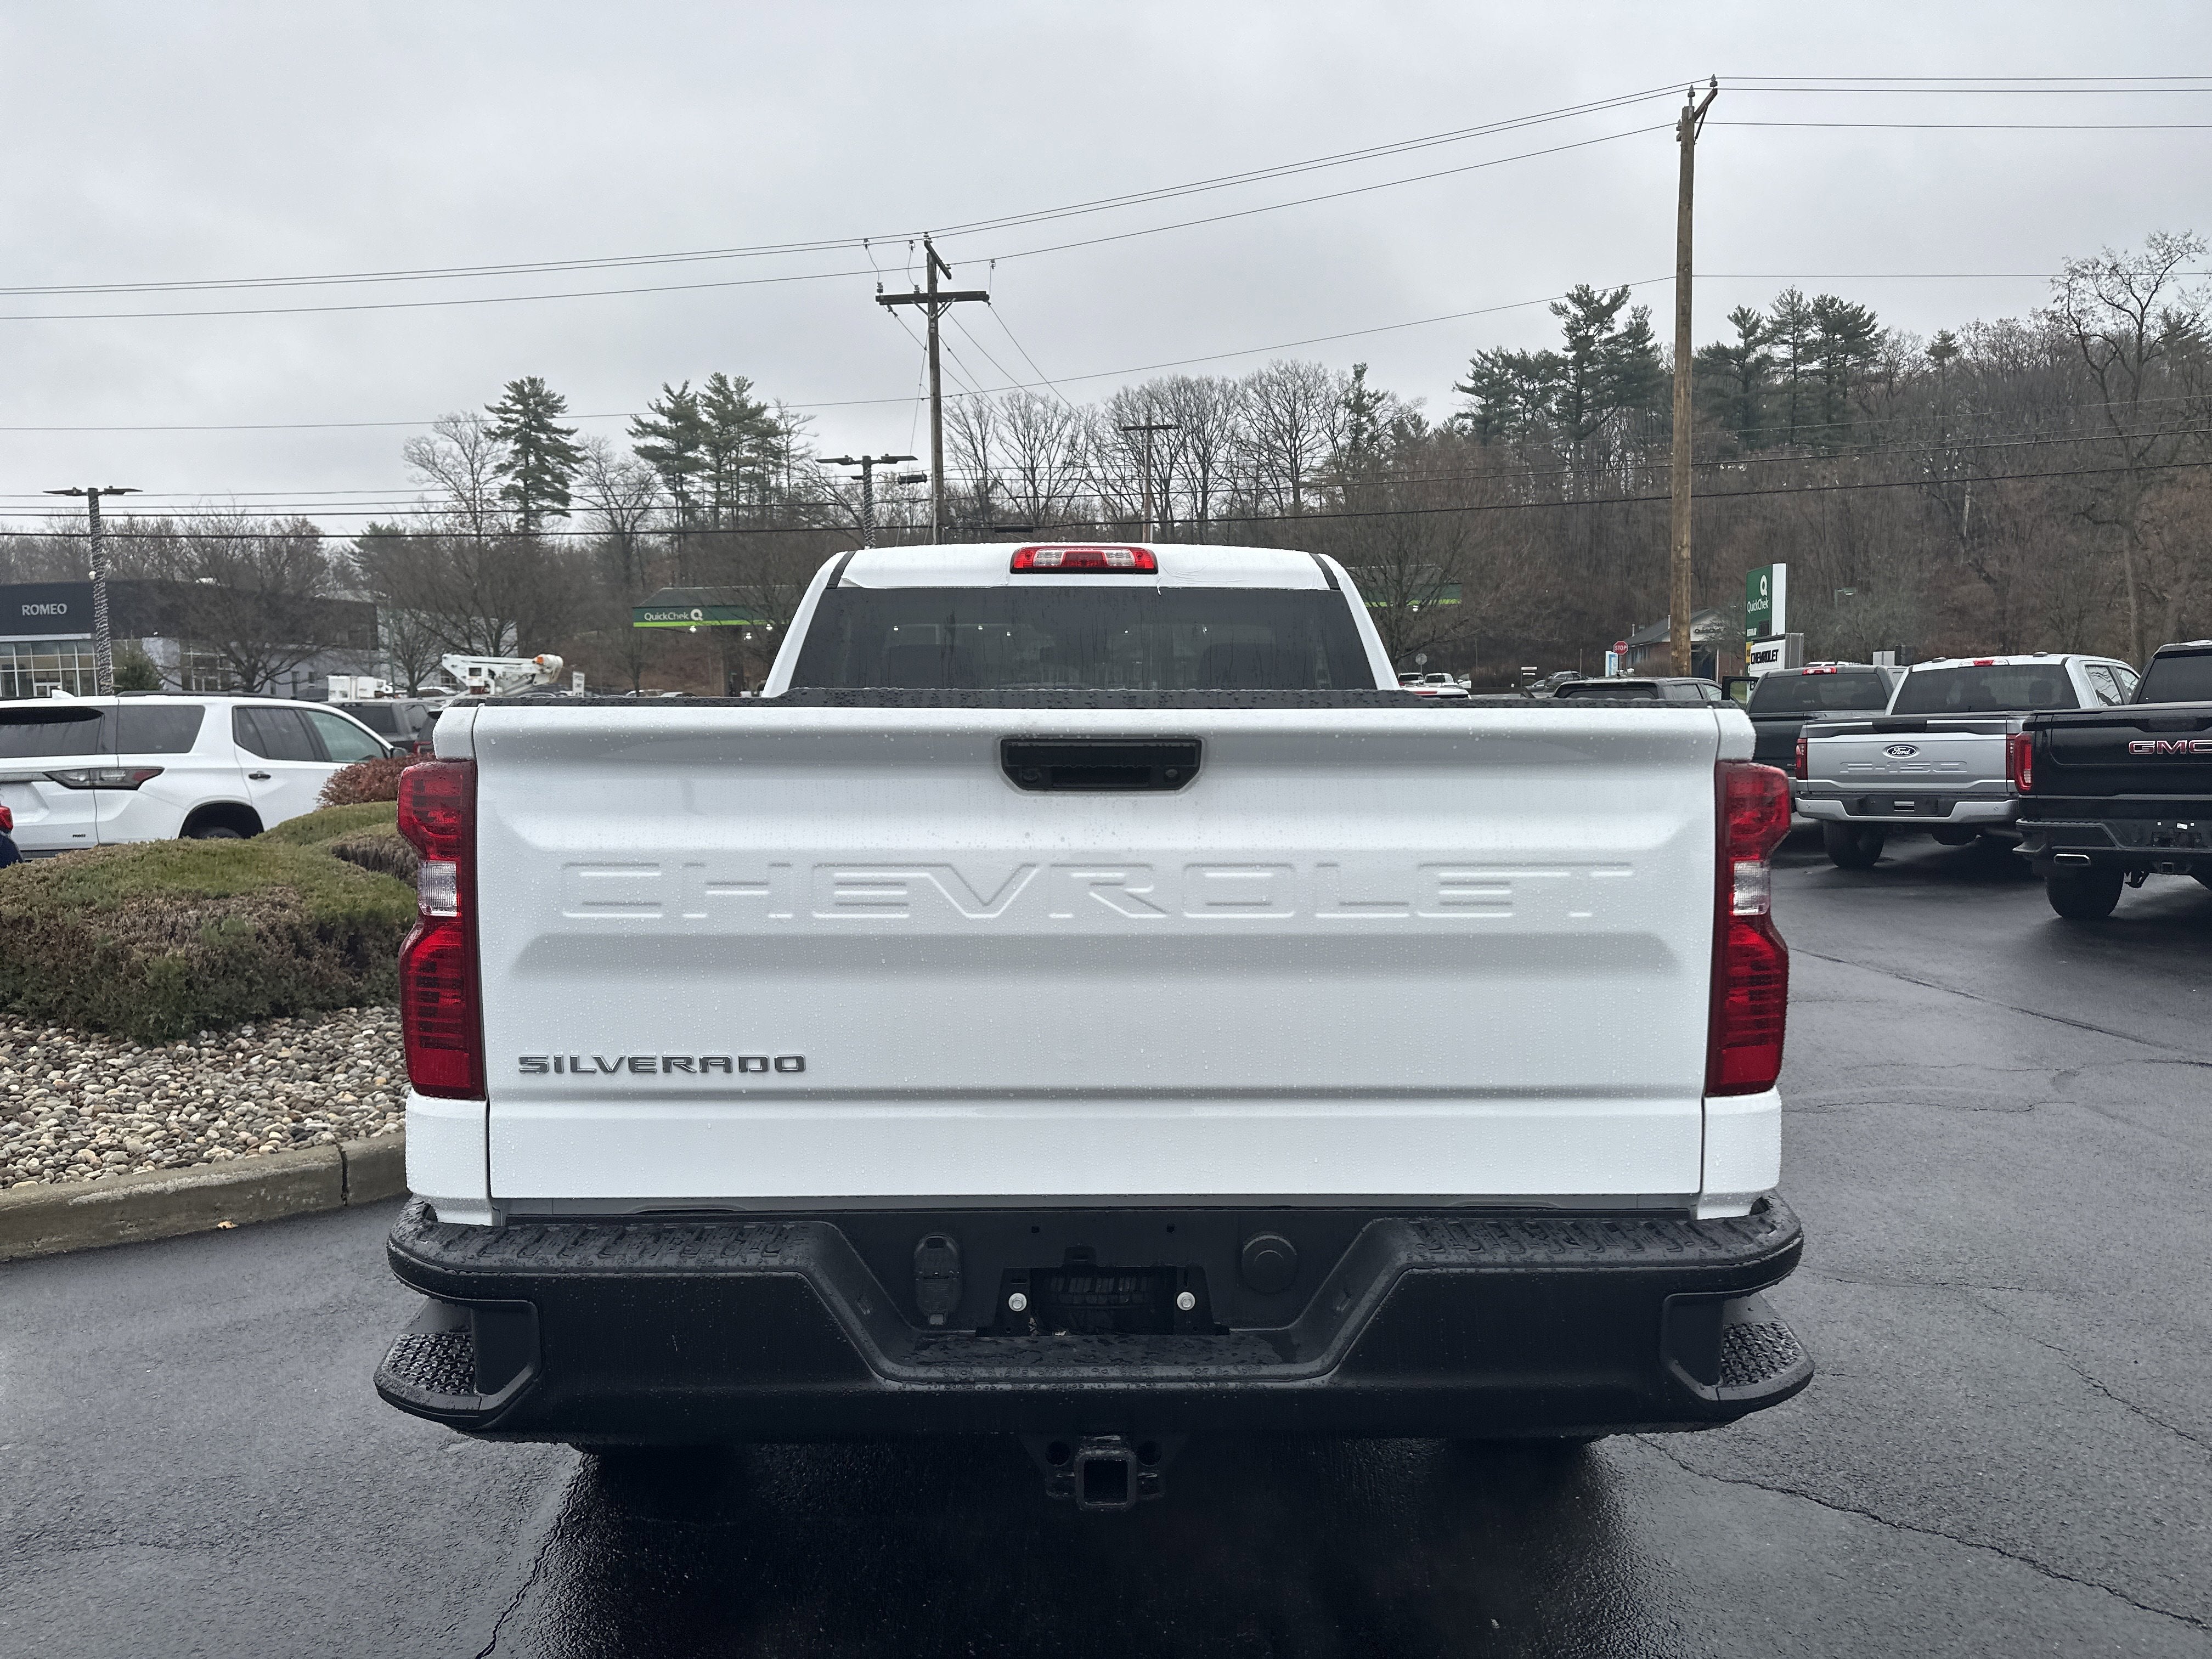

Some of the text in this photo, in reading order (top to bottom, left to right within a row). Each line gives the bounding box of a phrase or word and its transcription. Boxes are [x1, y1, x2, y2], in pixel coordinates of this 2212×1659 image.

[22, 603, 67, 616] ROMEO
[1747, 597, 1769, 614] QuickChek
[644, 612, 690, 621] QuickChek
[2129, 740, 2212, 755] GMC
[1839, 760, 1968, 774] F-150
[561, 861, 1634, 919] CHEVROLET
[518, 1054, 806, 1074] SILVERADO
